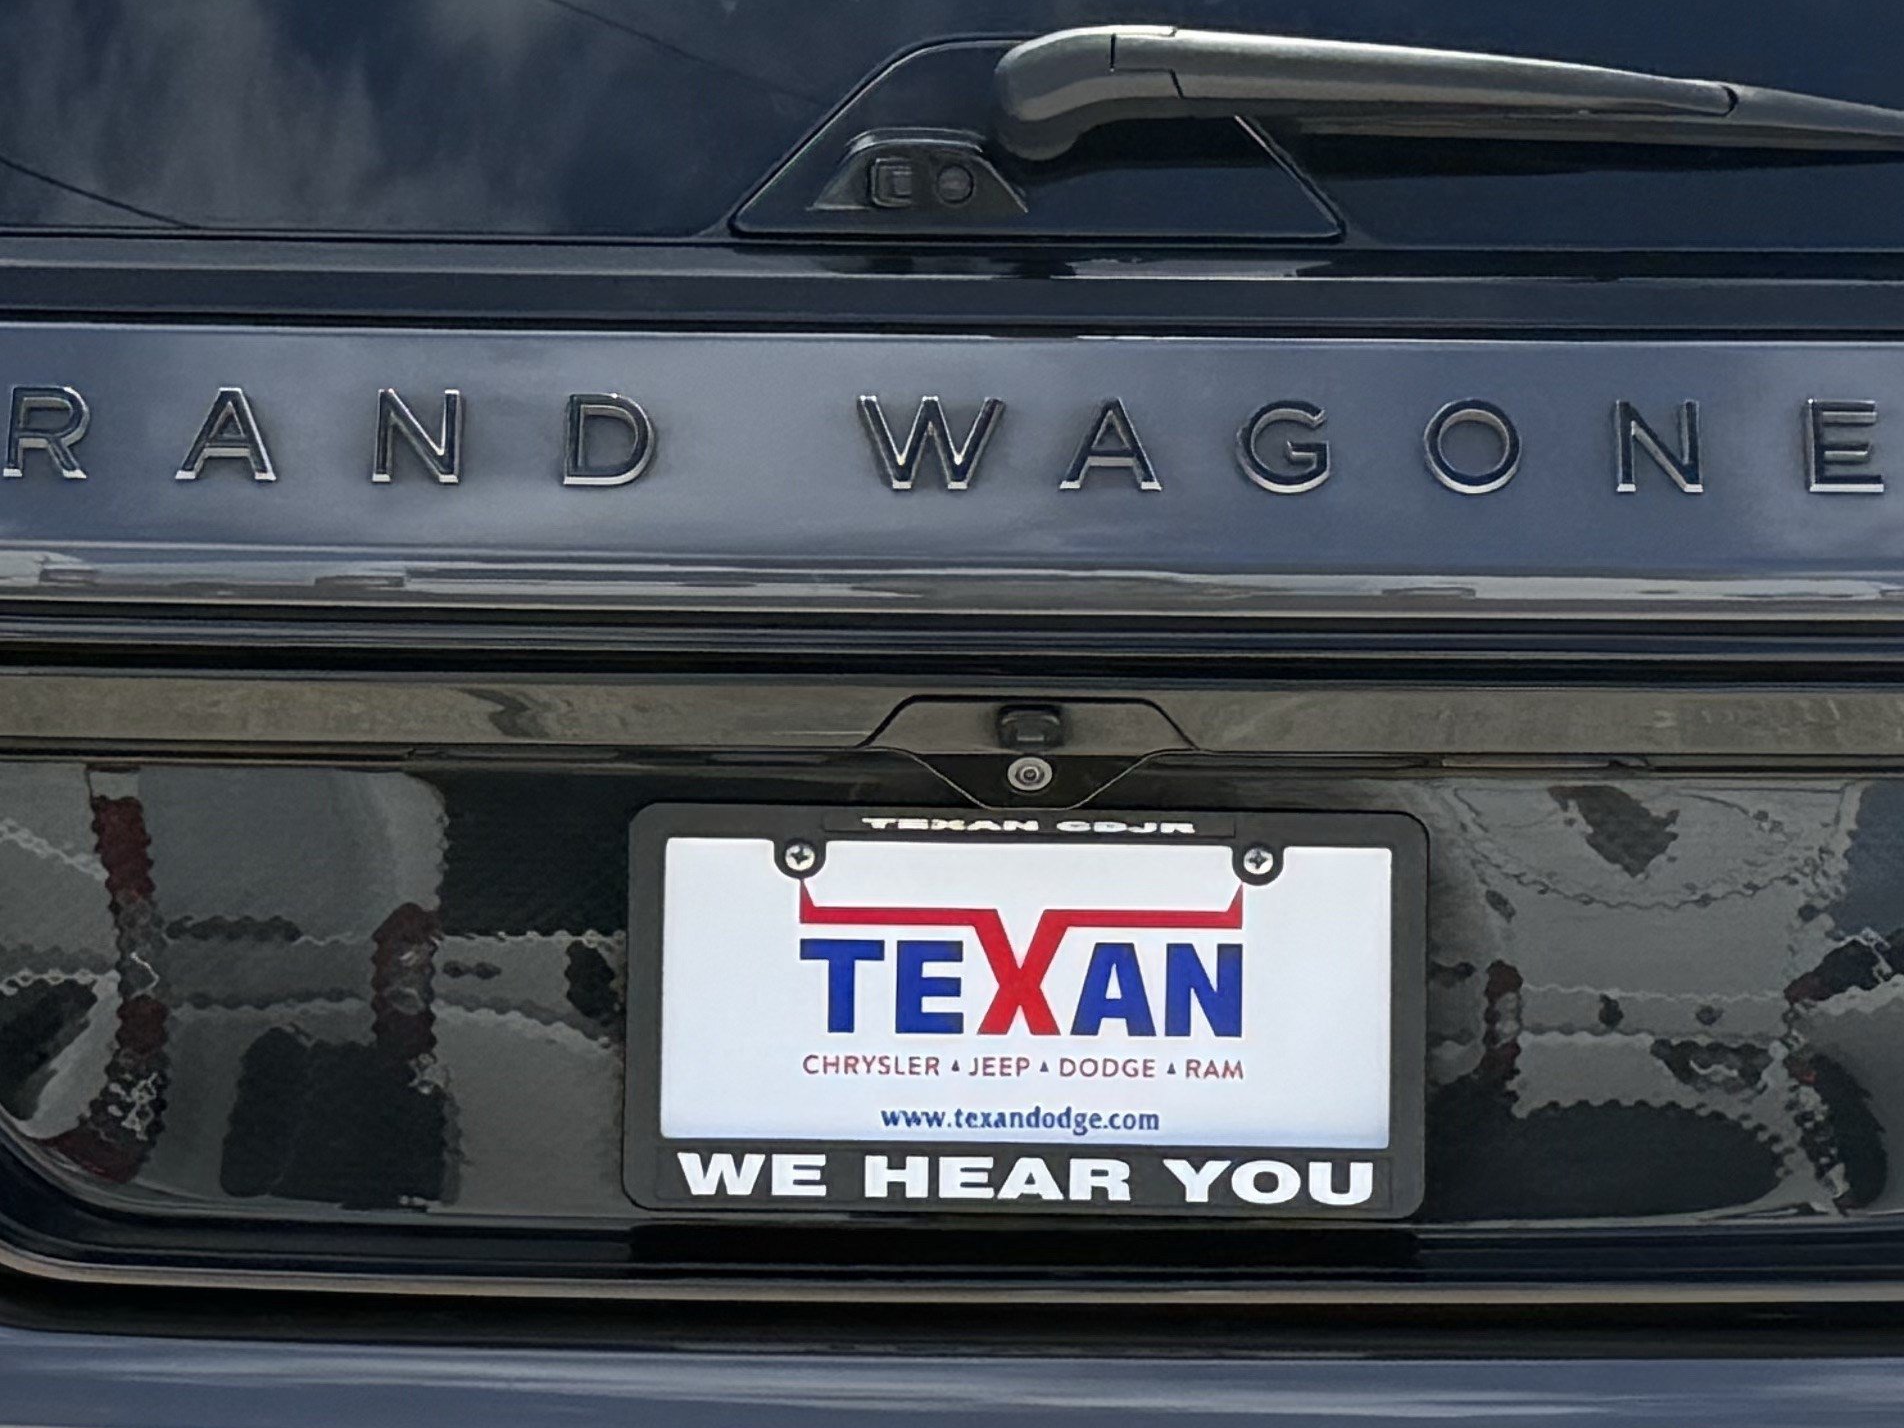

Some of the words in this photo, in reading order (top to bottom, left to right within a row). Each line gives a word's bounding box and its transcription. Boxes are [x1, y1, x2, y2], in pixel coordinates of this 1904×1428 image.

[861, 817, 1039, 830] TEXAN
[798, 909, 1244, 1038] TEXAN
[802, 1054, 940, 1076] CHRYSLER
[968, 1057, 1031, 1078] JEEP
[1058, 1058, 1156, 1079] DODGE
[1184, 1060, 1245, 1080] RAM
[880, 1105, 1160, 1136] www.texandodge.com
[676, 1152, 828, 1197] WE
[863, 1155, 1132, 1202] HEAR
[1161, 1158, 1375, 1206] YOU
